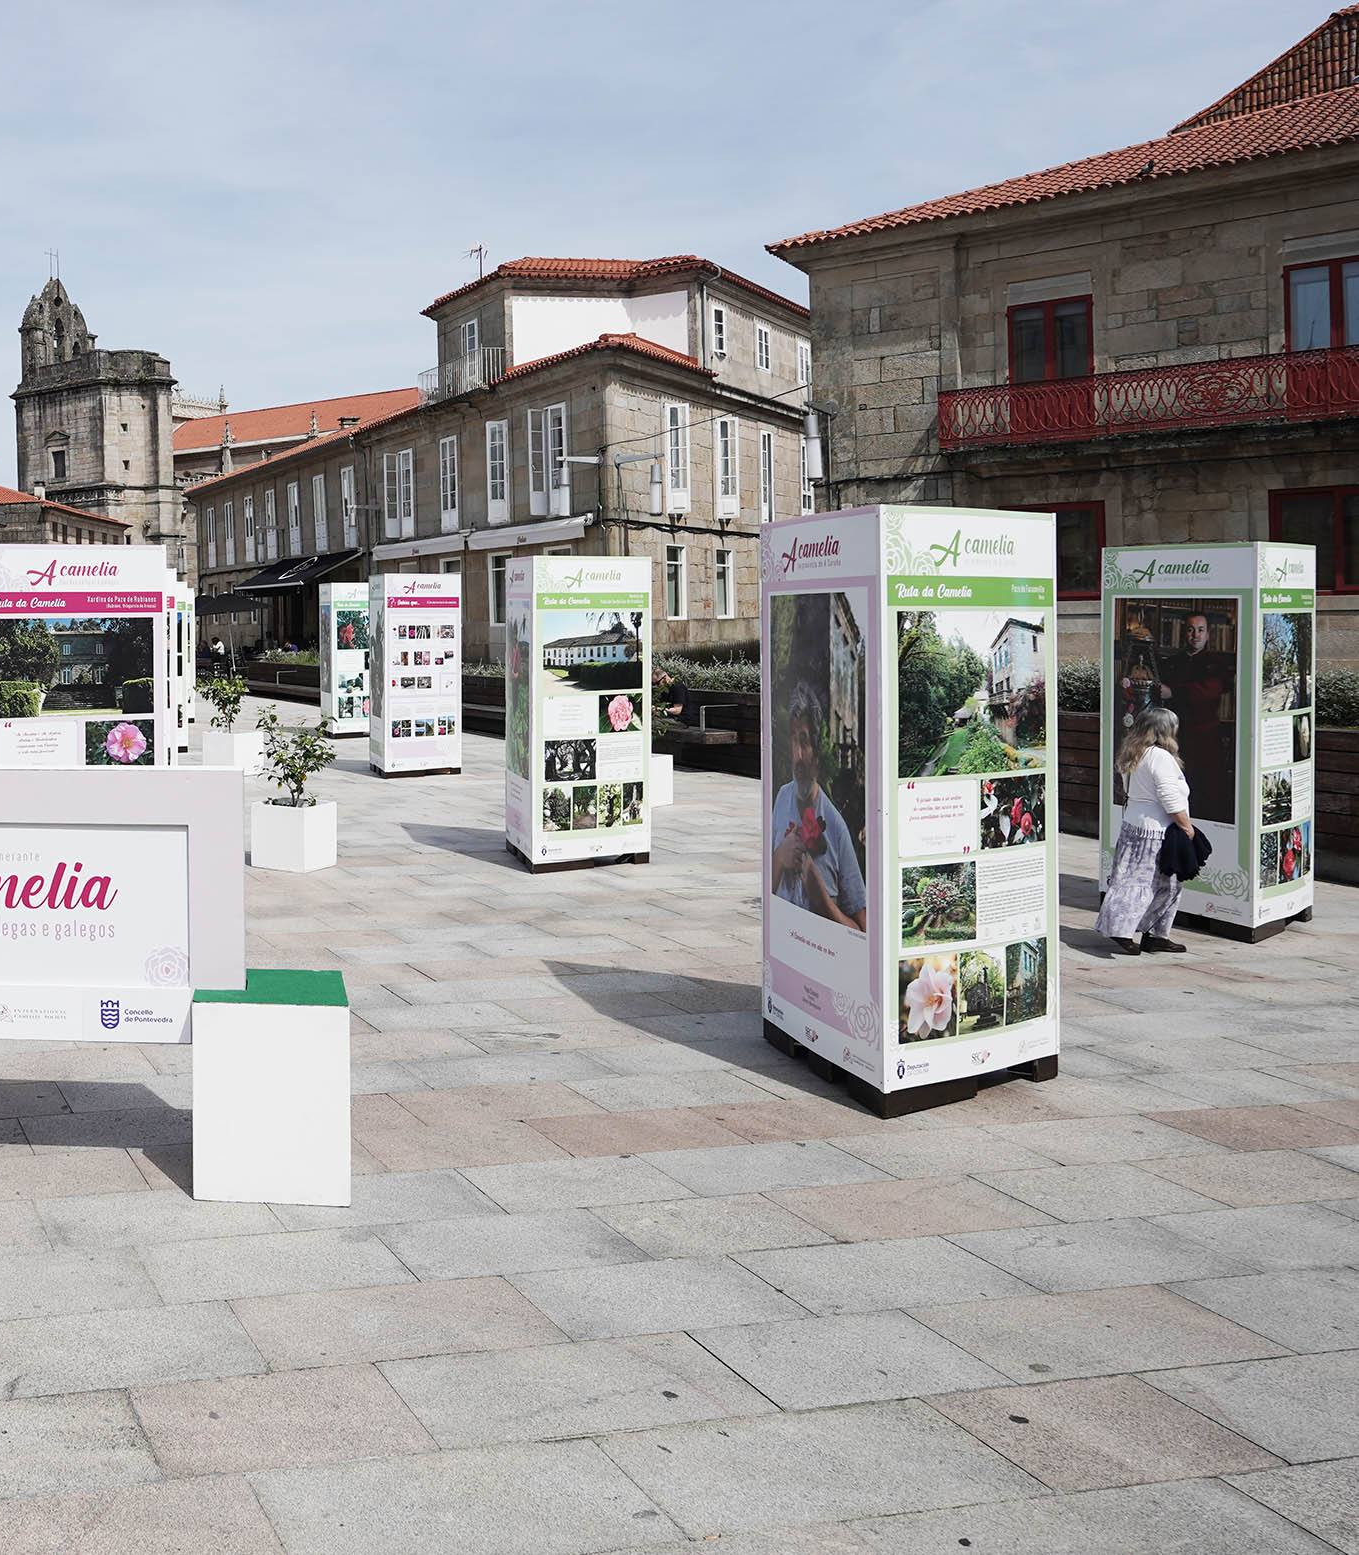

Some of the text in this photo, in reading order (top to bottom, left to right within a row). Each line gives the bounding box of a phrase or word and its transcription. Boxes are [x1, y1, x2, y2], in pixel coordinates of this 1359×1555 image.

[782, 535, 840, 573] A camelia
[930, 529, 1016, 567] A camelia
[26, 559, 57, 586] A
[60, 562, 119, 577] camelia
[563, 567, 621, 588] A camelia
[1132, 559, 1211, 584] A camelia
[403, 580, 416, 594] A
[895, 583, 973, 599] Ruta da Camelia
[16, 598, 28, 608] da
[30, 597, 66, 609] Camelia
[42, 923, 49, 937] e
[54, 919, 115, 941] galegos
[124, 1008, 153, 1016] Concello
